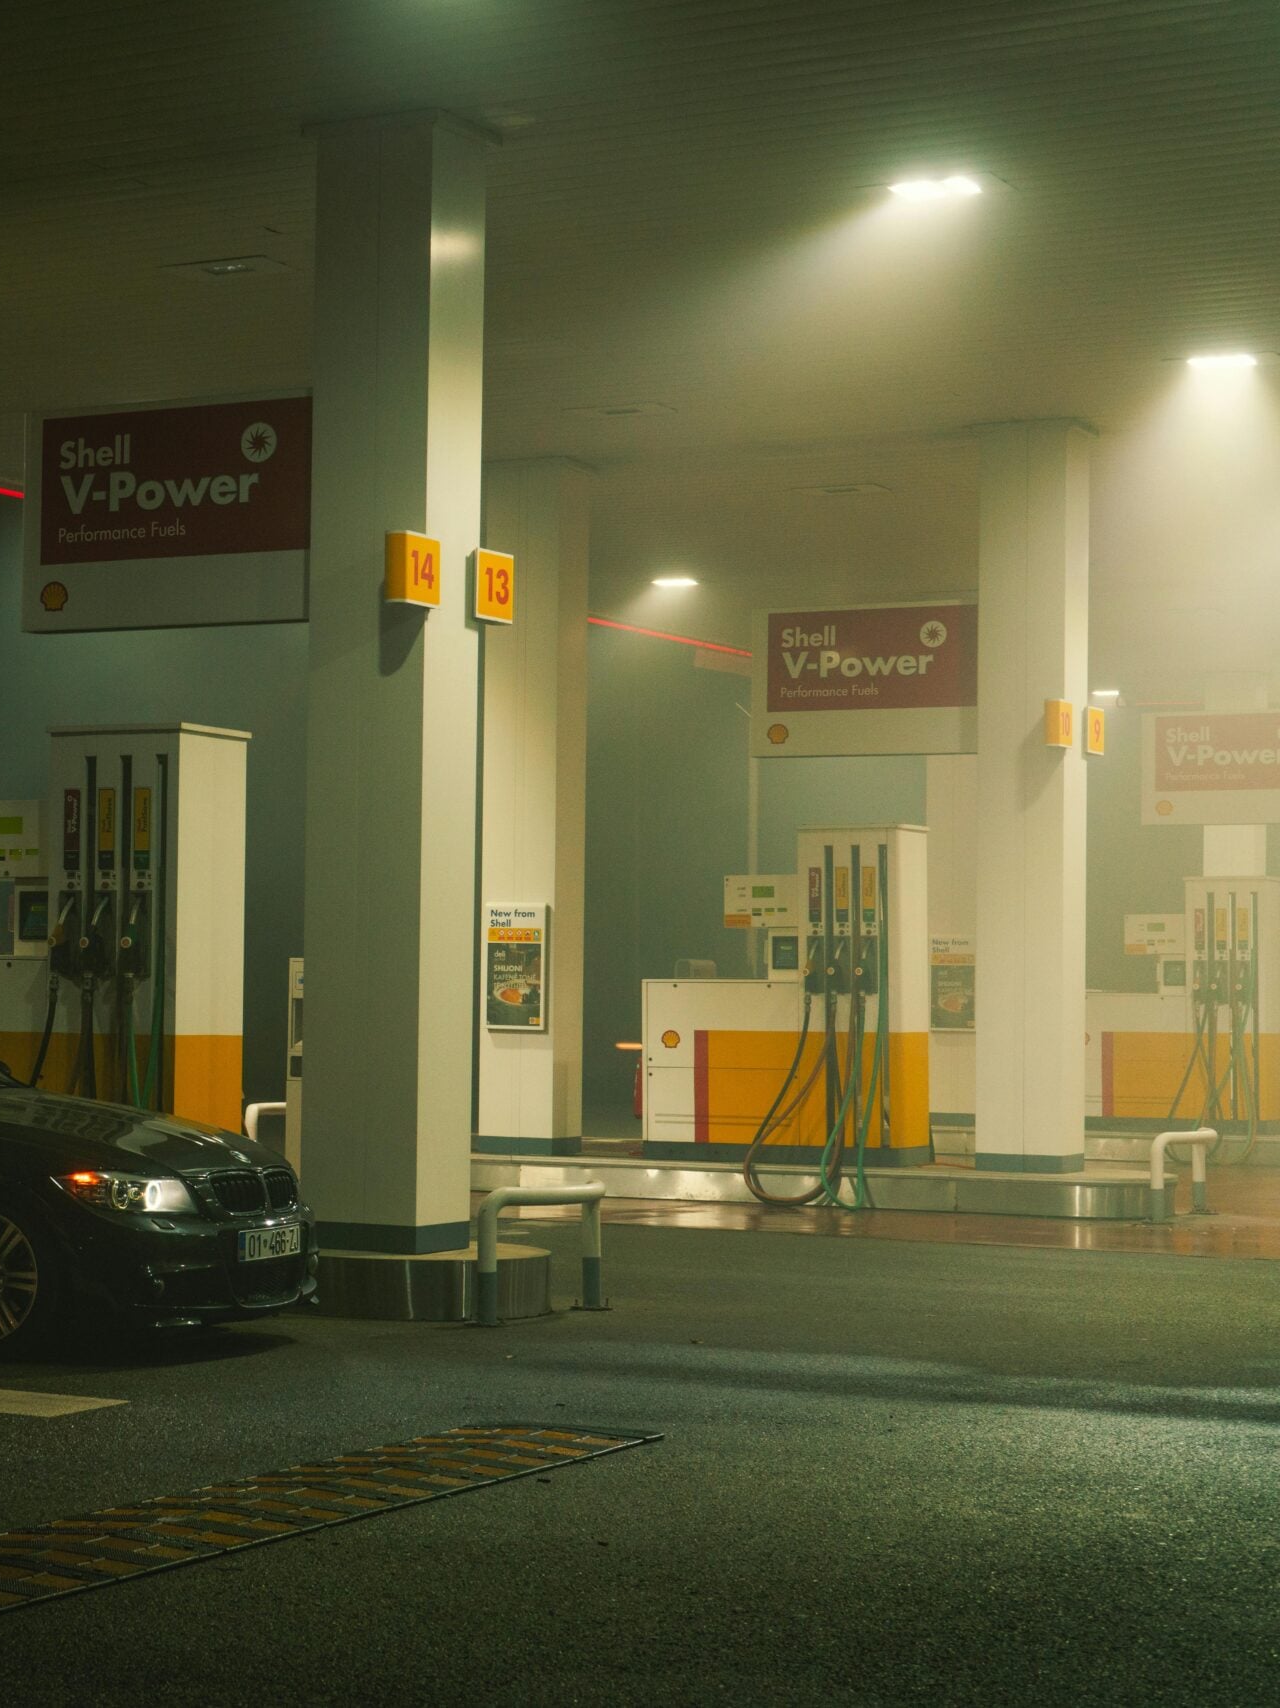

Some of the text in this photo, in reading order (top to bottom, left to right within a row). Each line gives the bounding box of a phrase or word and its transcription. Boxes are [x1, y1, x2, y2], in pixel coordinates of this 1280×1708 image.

[59, 434, 131, 471] Shell
[60, 470, 259, 515] V-Power
[57, 518, 186, 544] Performance Fuels
[411, 549, 435, 590] 14
[484, 567, 510, 605] 13
[781, 625, 837, 649] Shell
[782, 650, 934, 679] V-Power
[780, 682, 880, 698] Performance Fuels
[1060, 712, 1070, 736] 10
[1094, 719, 1101, 742] 9
[1165, 726, 1211, 744] Shell
[490, 909, 535, 918] New from
[490, 919, 511, 927] Shell
